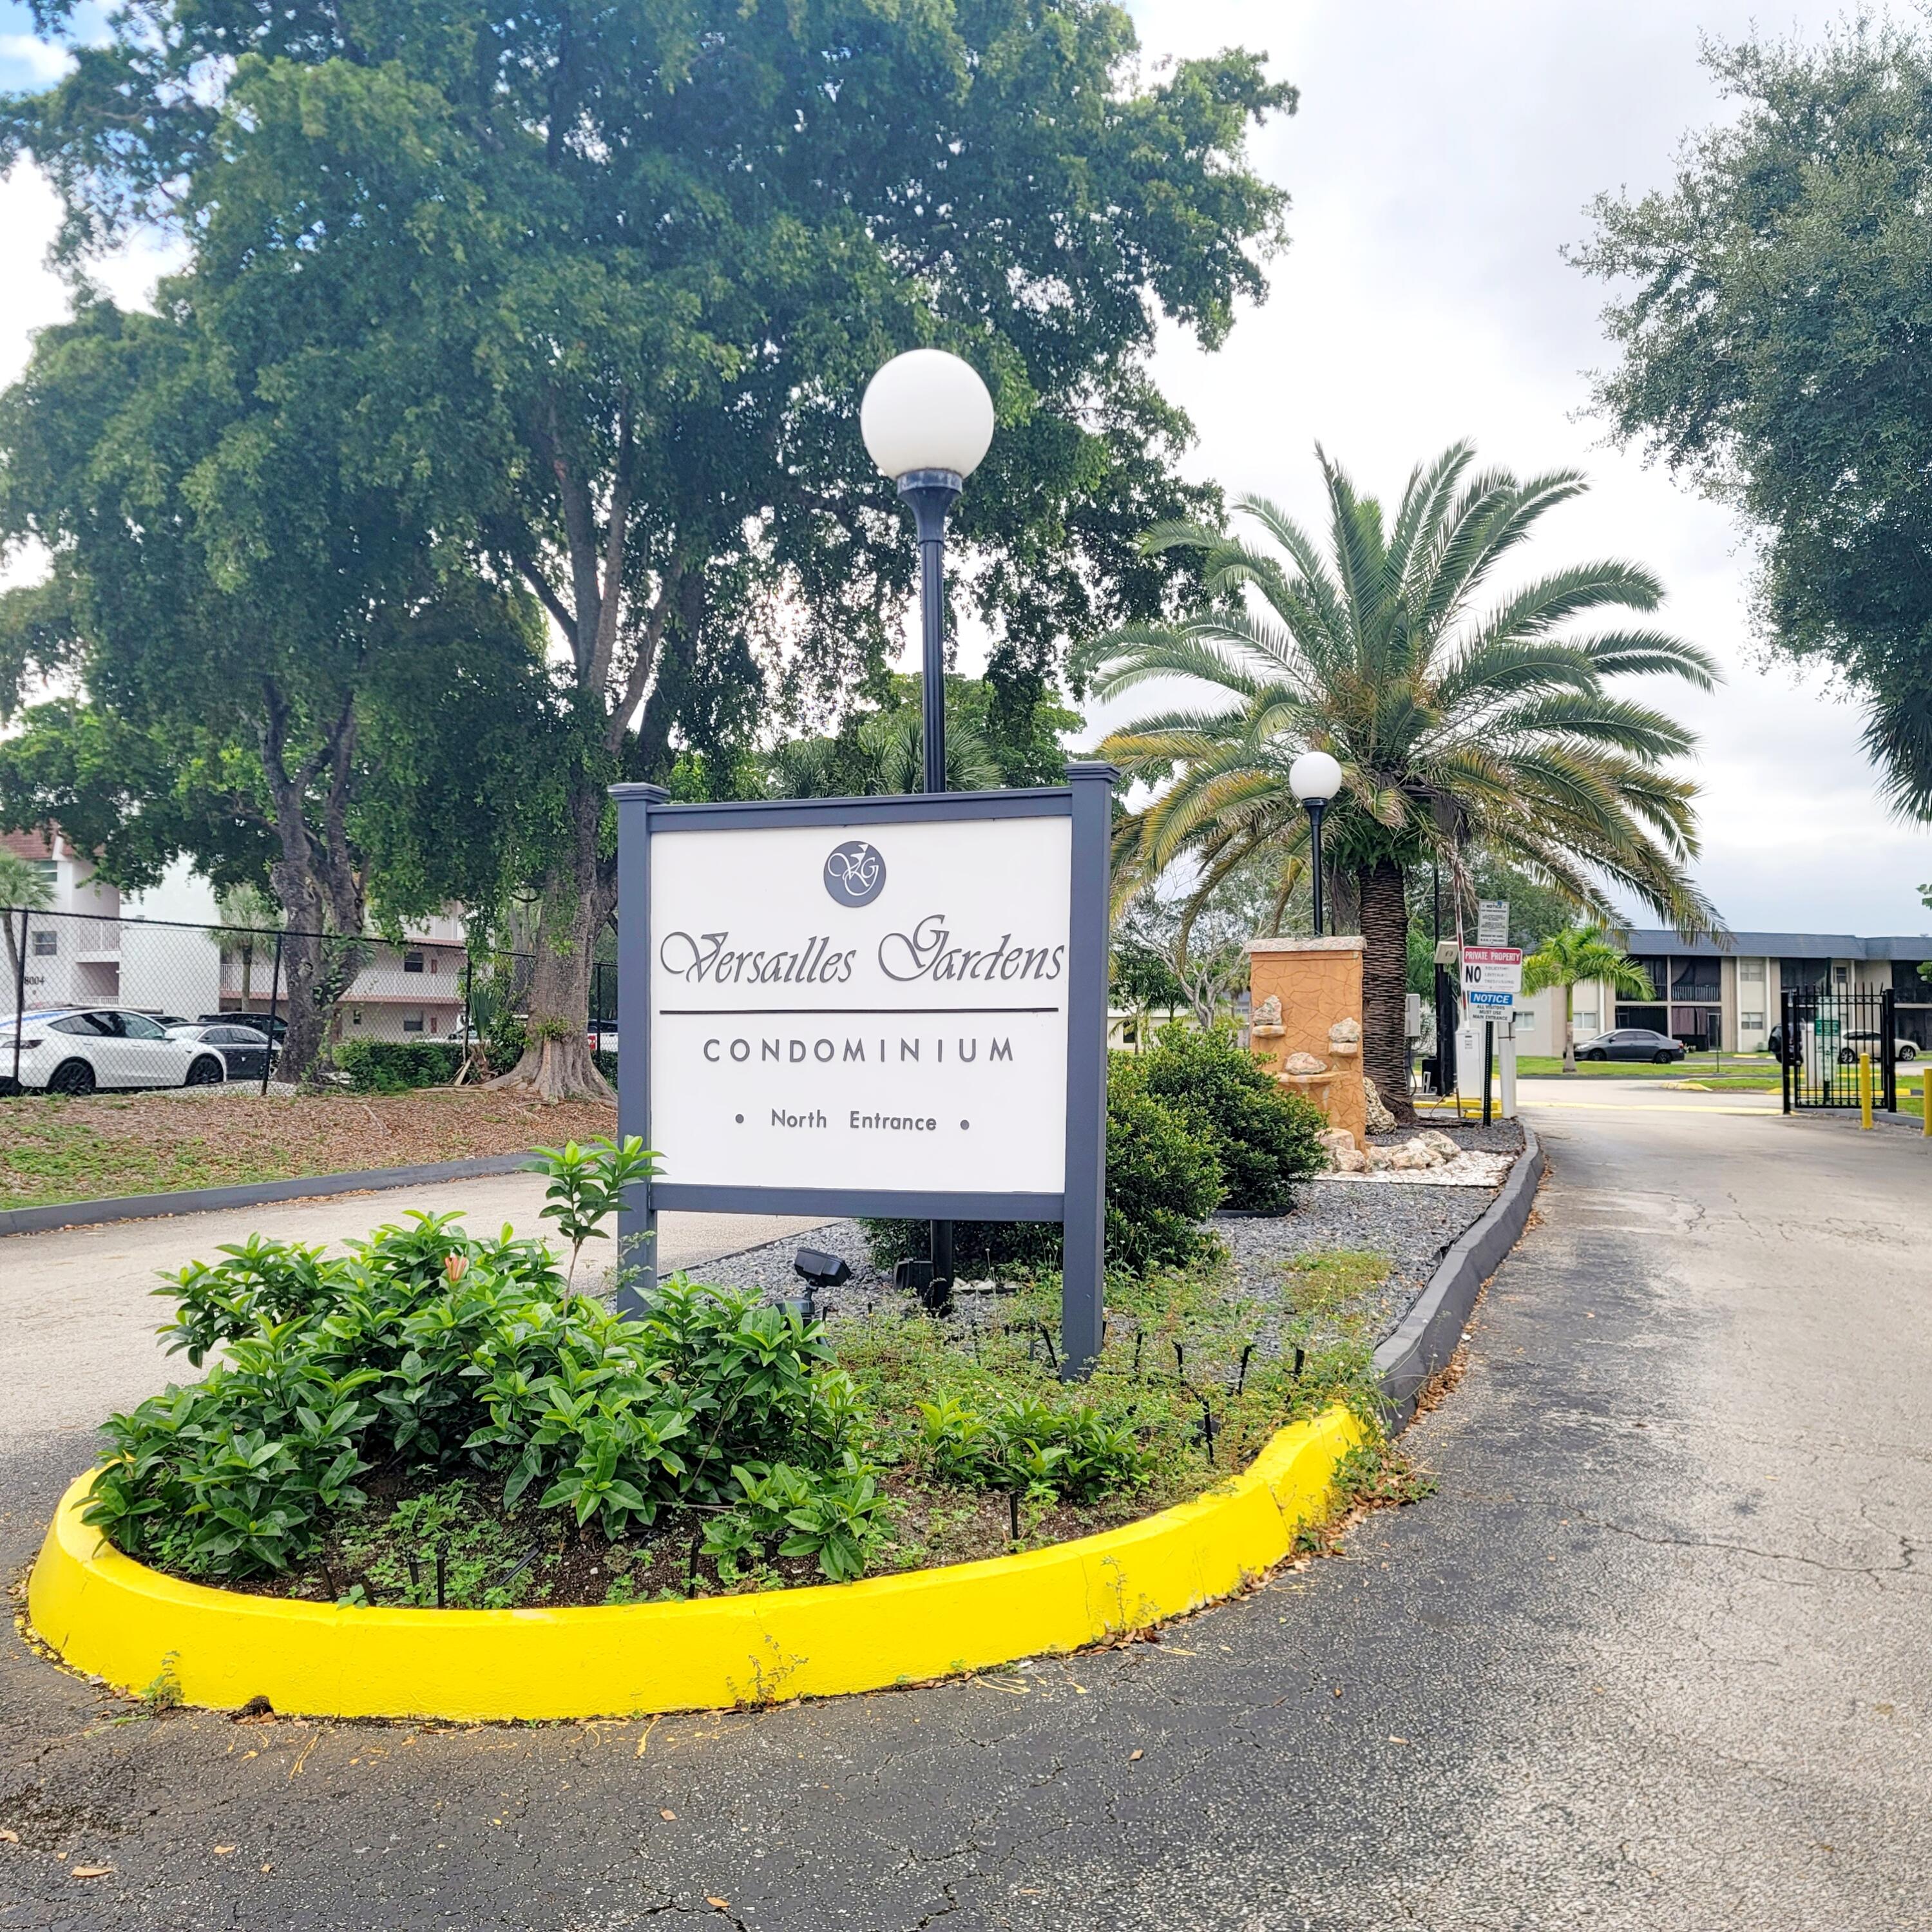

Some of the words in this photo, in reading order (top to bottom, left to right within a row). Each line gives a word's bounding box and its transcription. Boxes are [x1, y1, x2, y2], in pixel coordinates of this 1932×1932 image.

[660, 932, 857, 984] Versailles
[878, 914, 1065, 982] Gardens
[1465, 951, 1488, 960] PRIVATE
[1491, 952, 1520, 962] PROPERTY
[24, 976, 44, 986] 8004
[1465, 965, 1482, 983] NO
[1473, 993, 1510, 1004] NOTICE
[703, 1038, 1013, 1062] CONDOMINIUM
[772, 1109, 827, 1129] North
[850, 1111, 937, 1131] Entrance
